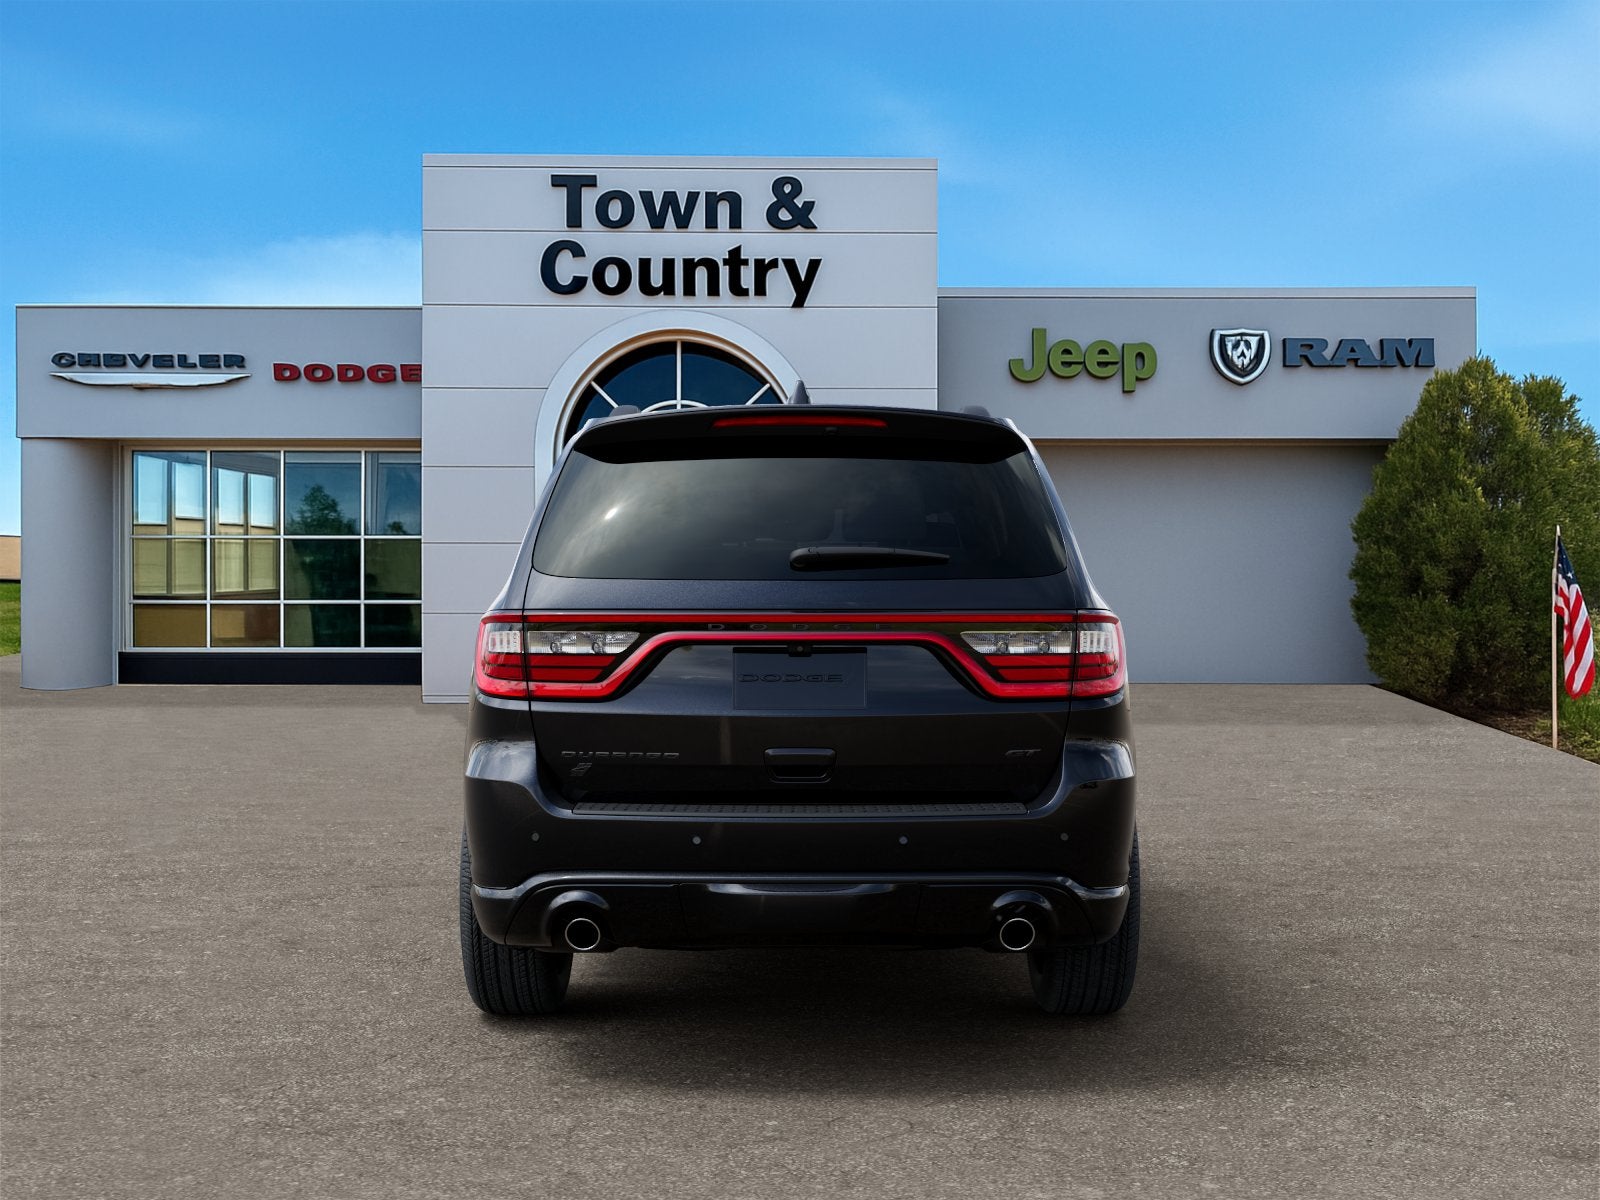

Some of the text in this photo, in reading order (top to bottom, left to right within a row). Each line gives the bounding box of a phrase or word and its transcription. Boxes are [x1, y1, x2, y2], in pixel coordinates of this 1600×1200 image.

[551, 174, 818, 230] Town &
[540, 239, 822, 308] Country
[273, 363, 422, 383] DODGE
[1009, 327, 1157, 393] Jeep
[1283, 337, 1435, 368] RAM
[737, 673, 844, 683] DODGE
